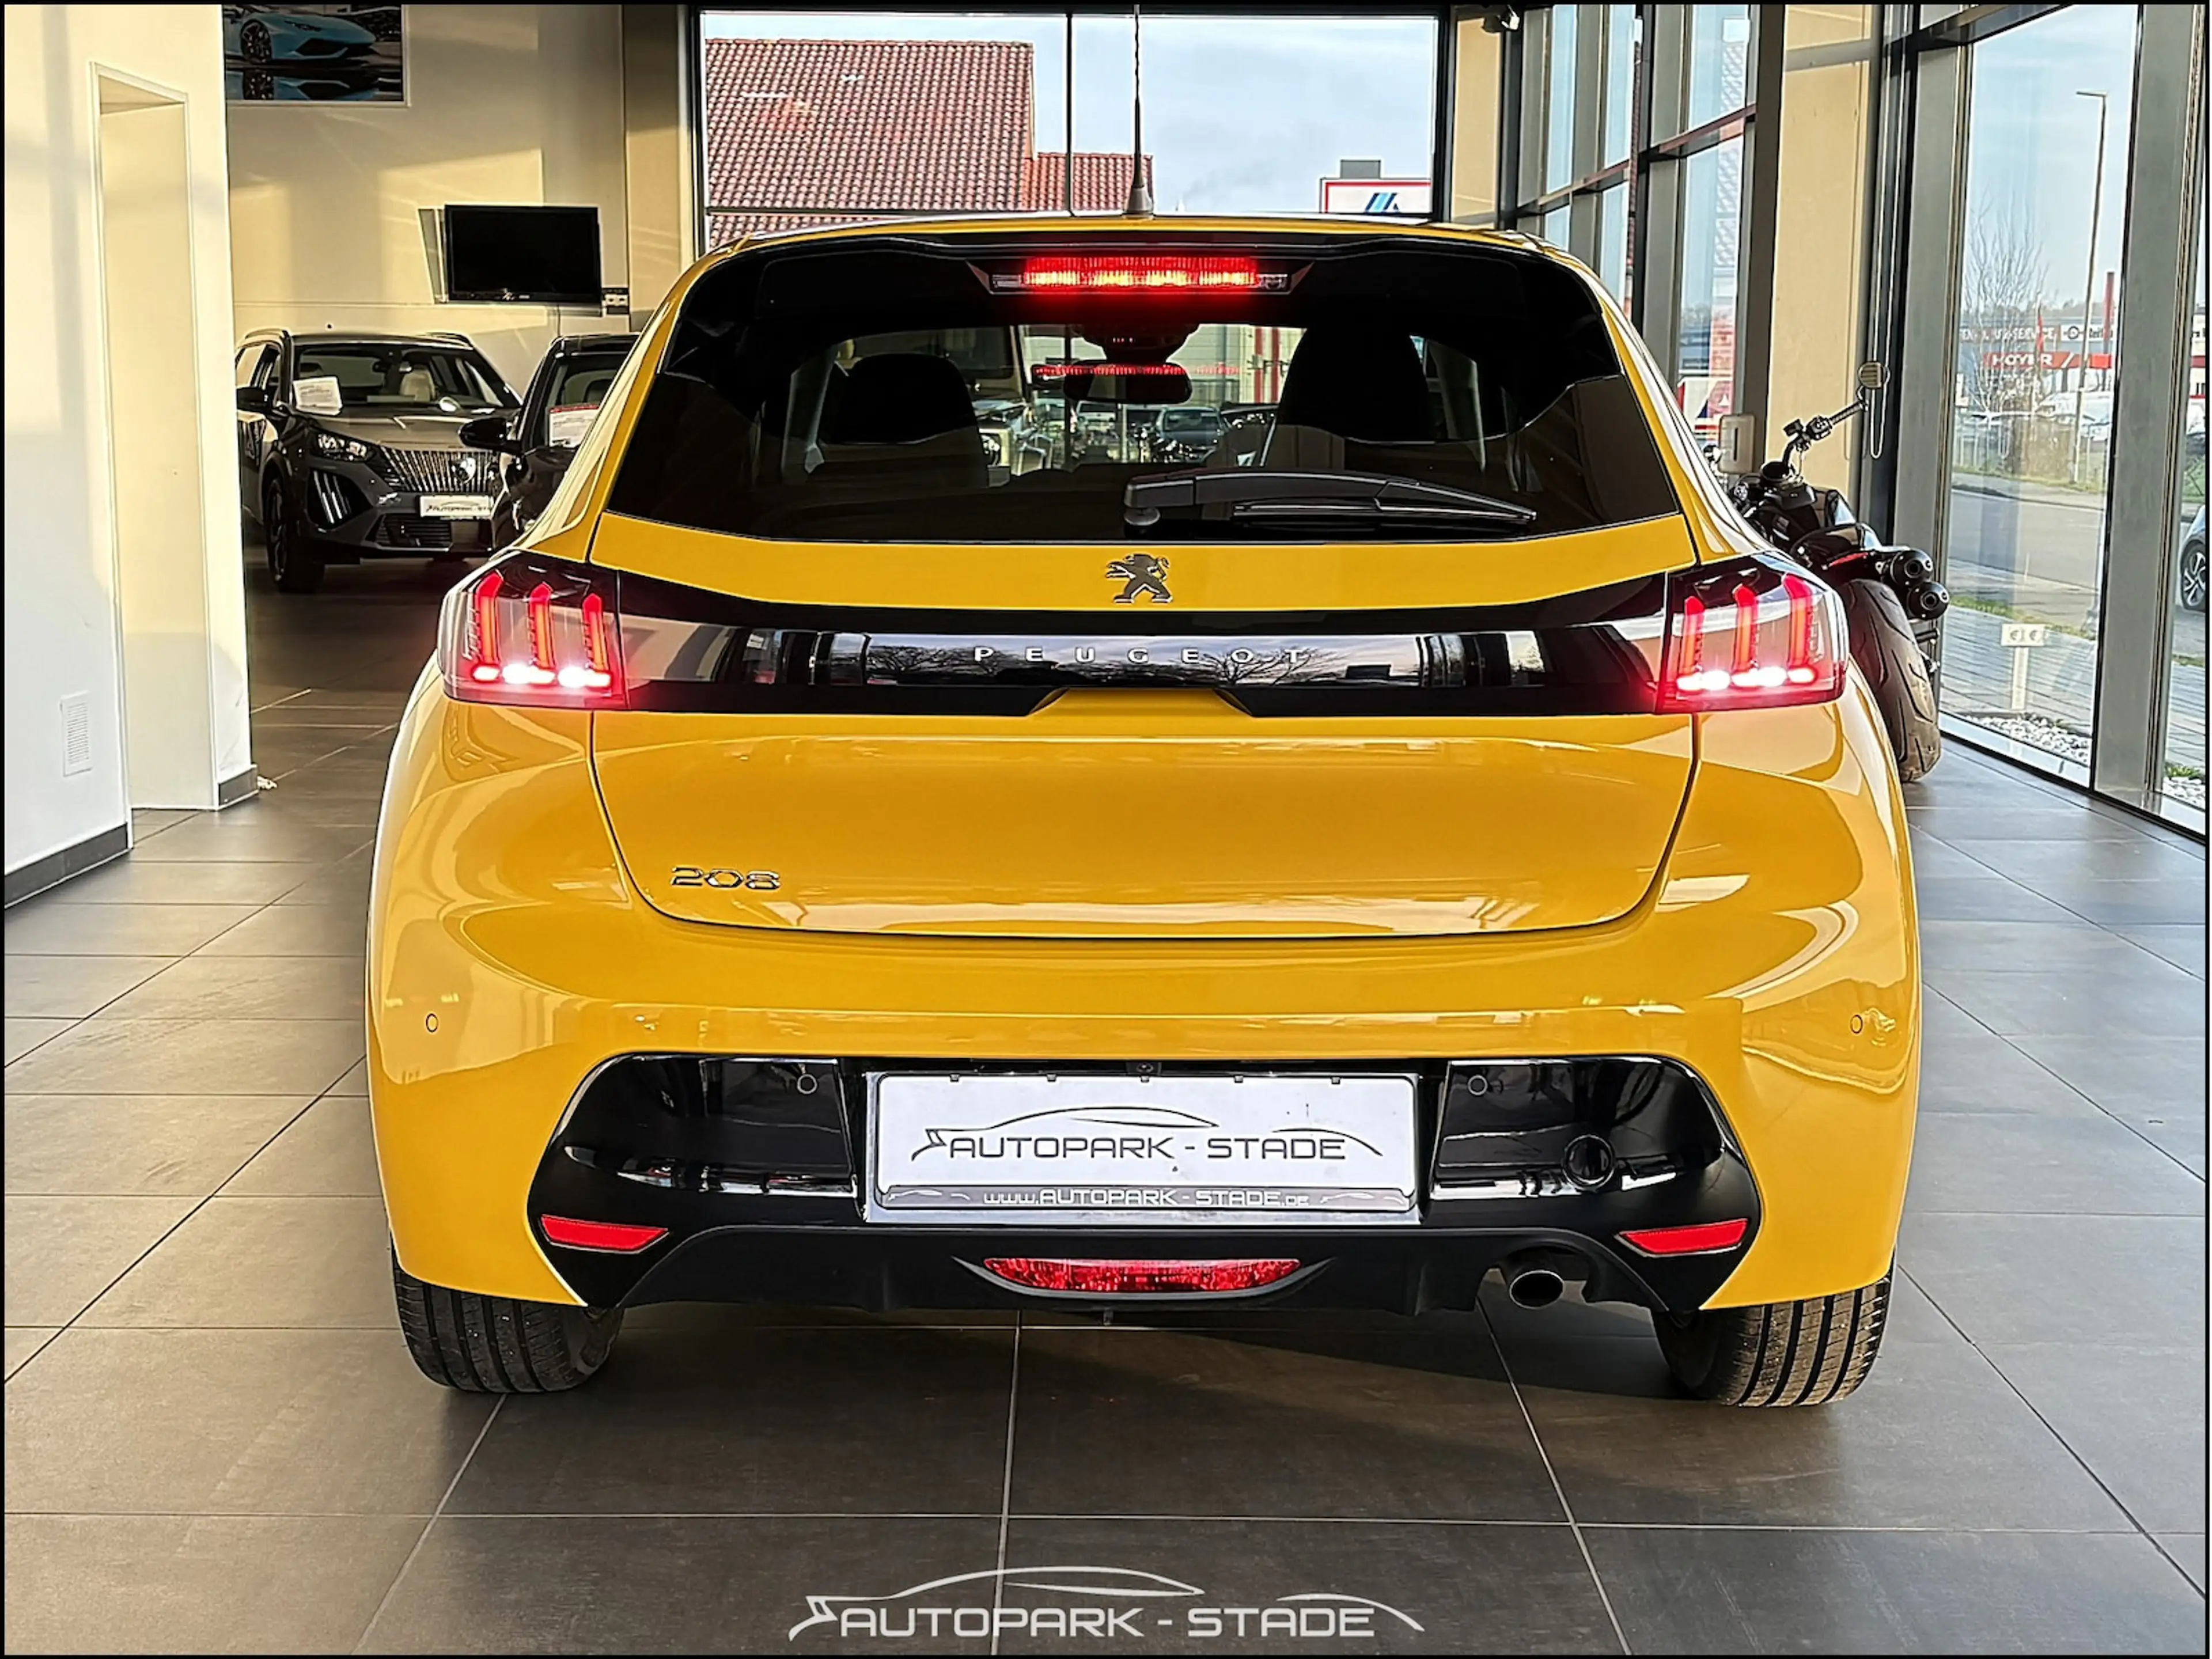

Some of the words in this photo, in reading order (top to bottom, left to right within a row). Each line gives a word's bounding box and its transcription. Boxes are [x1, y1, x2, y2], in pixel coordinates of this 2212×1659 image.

[974, 647, 1303, 662] PEUGEOT
[671, 866, 781, 890] 208
[950, 1137, 1173, 1158] AUTOPARK
[1207, 1138, 1346, 1160] STADE
